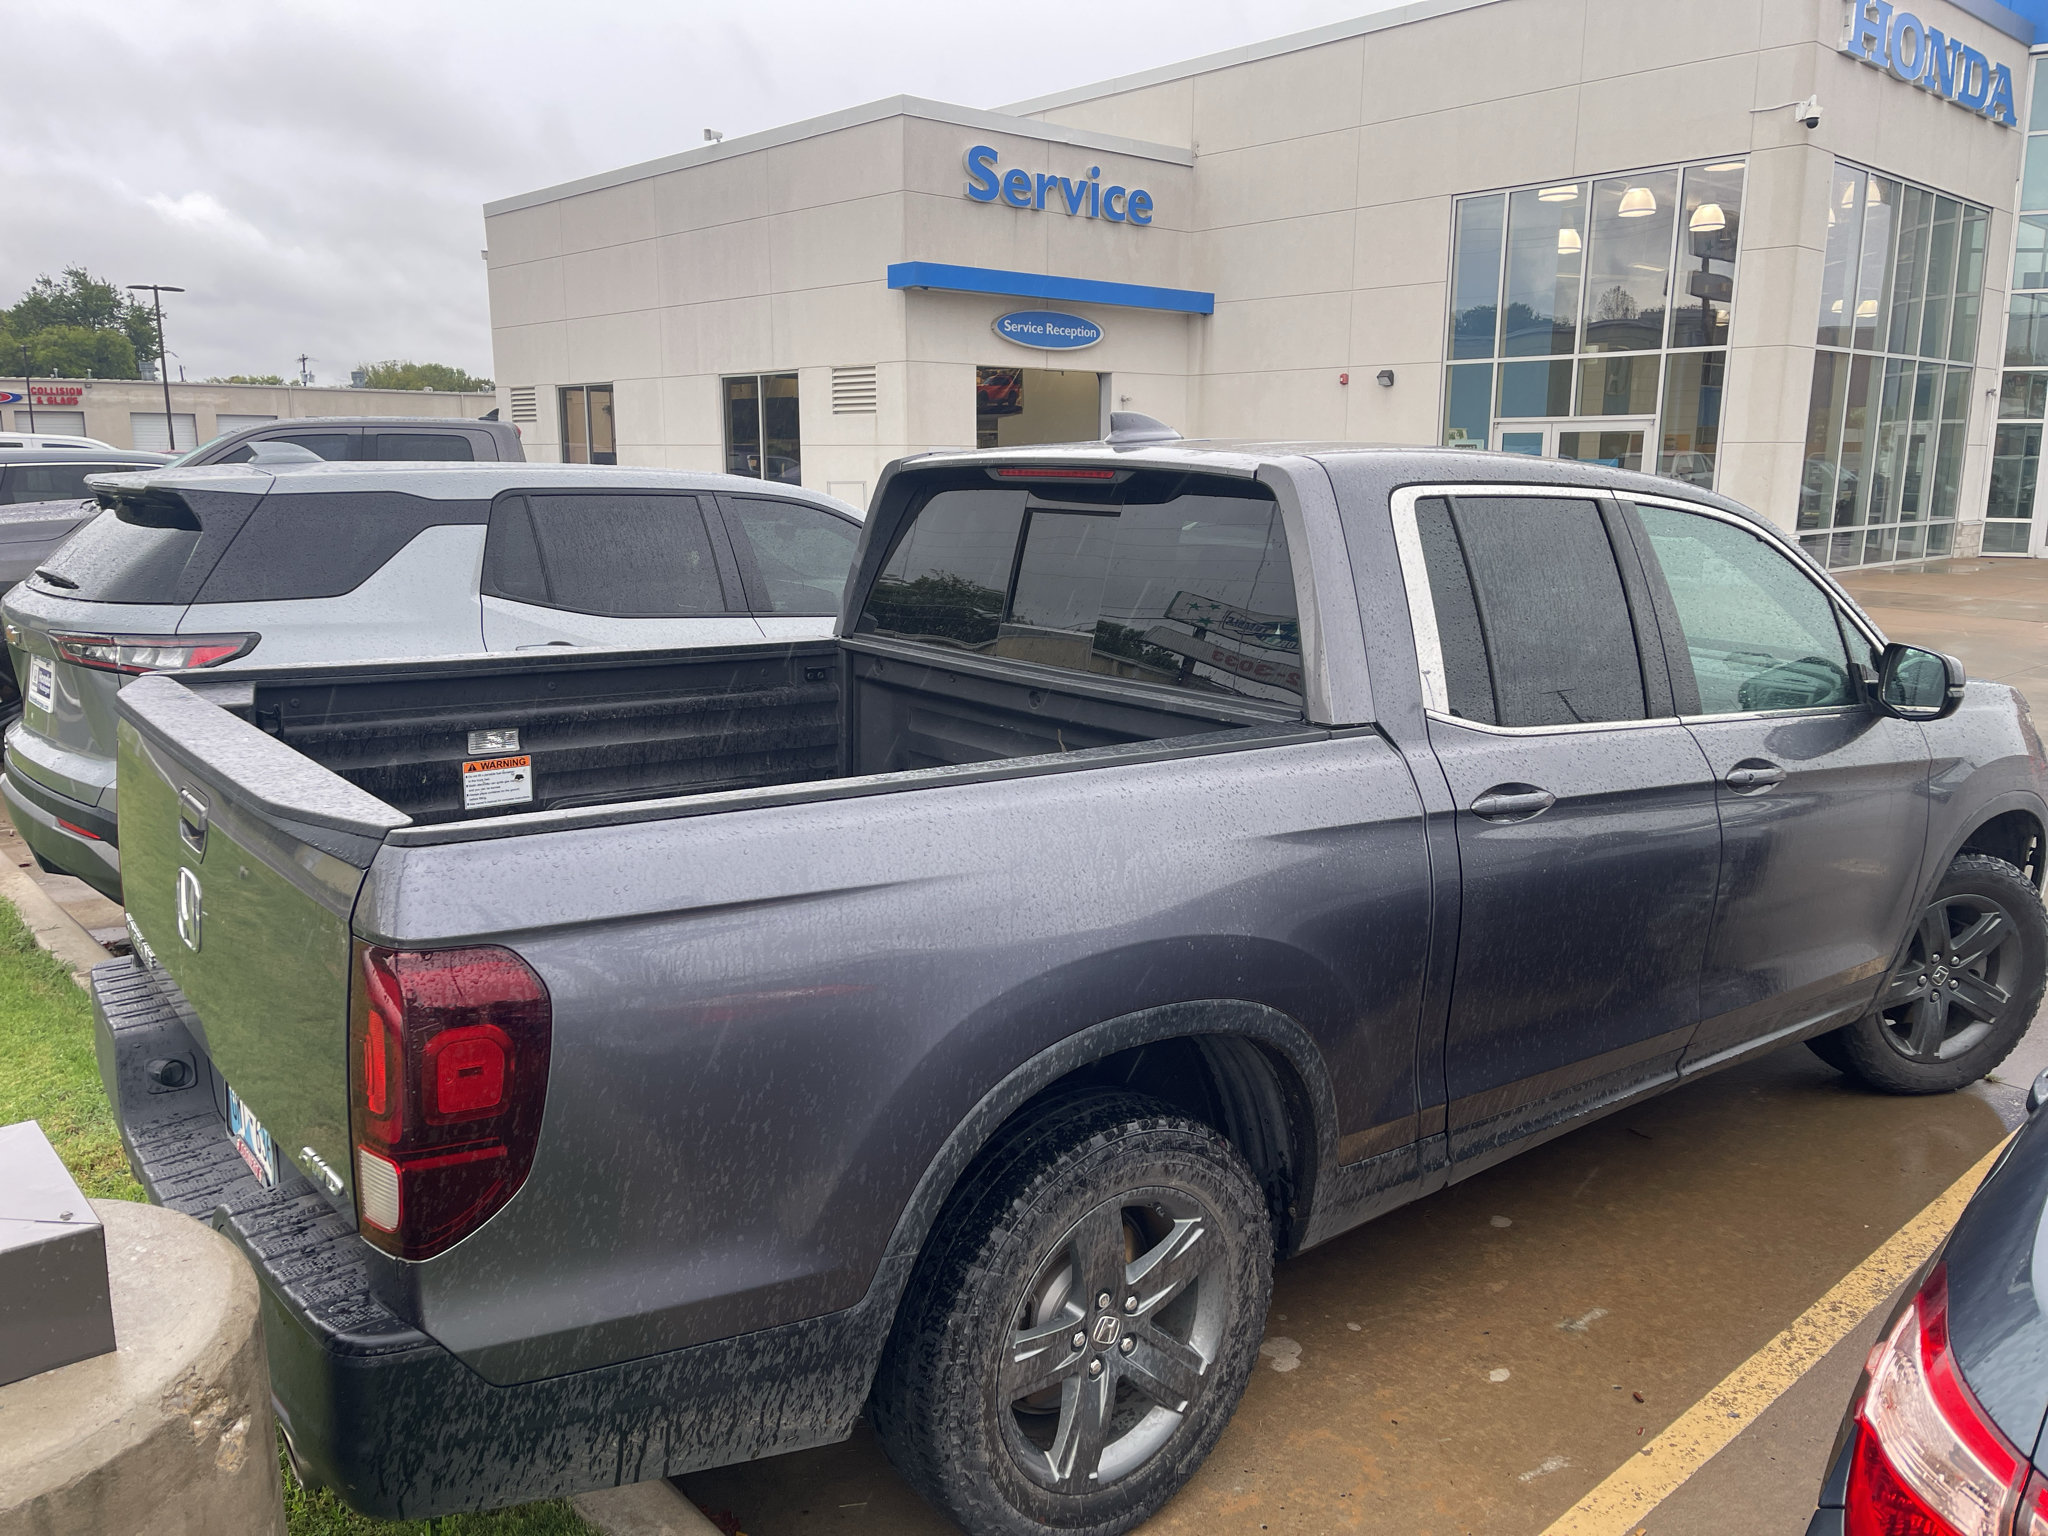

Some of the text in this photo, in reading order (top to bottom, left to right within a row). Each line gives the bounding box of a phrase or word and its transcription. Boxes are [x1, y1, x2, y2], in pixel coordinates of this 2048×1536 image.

[1847, 0, 2017, 127] HONDA
[963, 145, 1153, 225] Service
[1004, 320, 1097, 339] Service Reception
[30, 386, 83, 396] COLLISION
[47, 396, 79, 406] GLASS
[480, 758, 526, 770] WARNING
